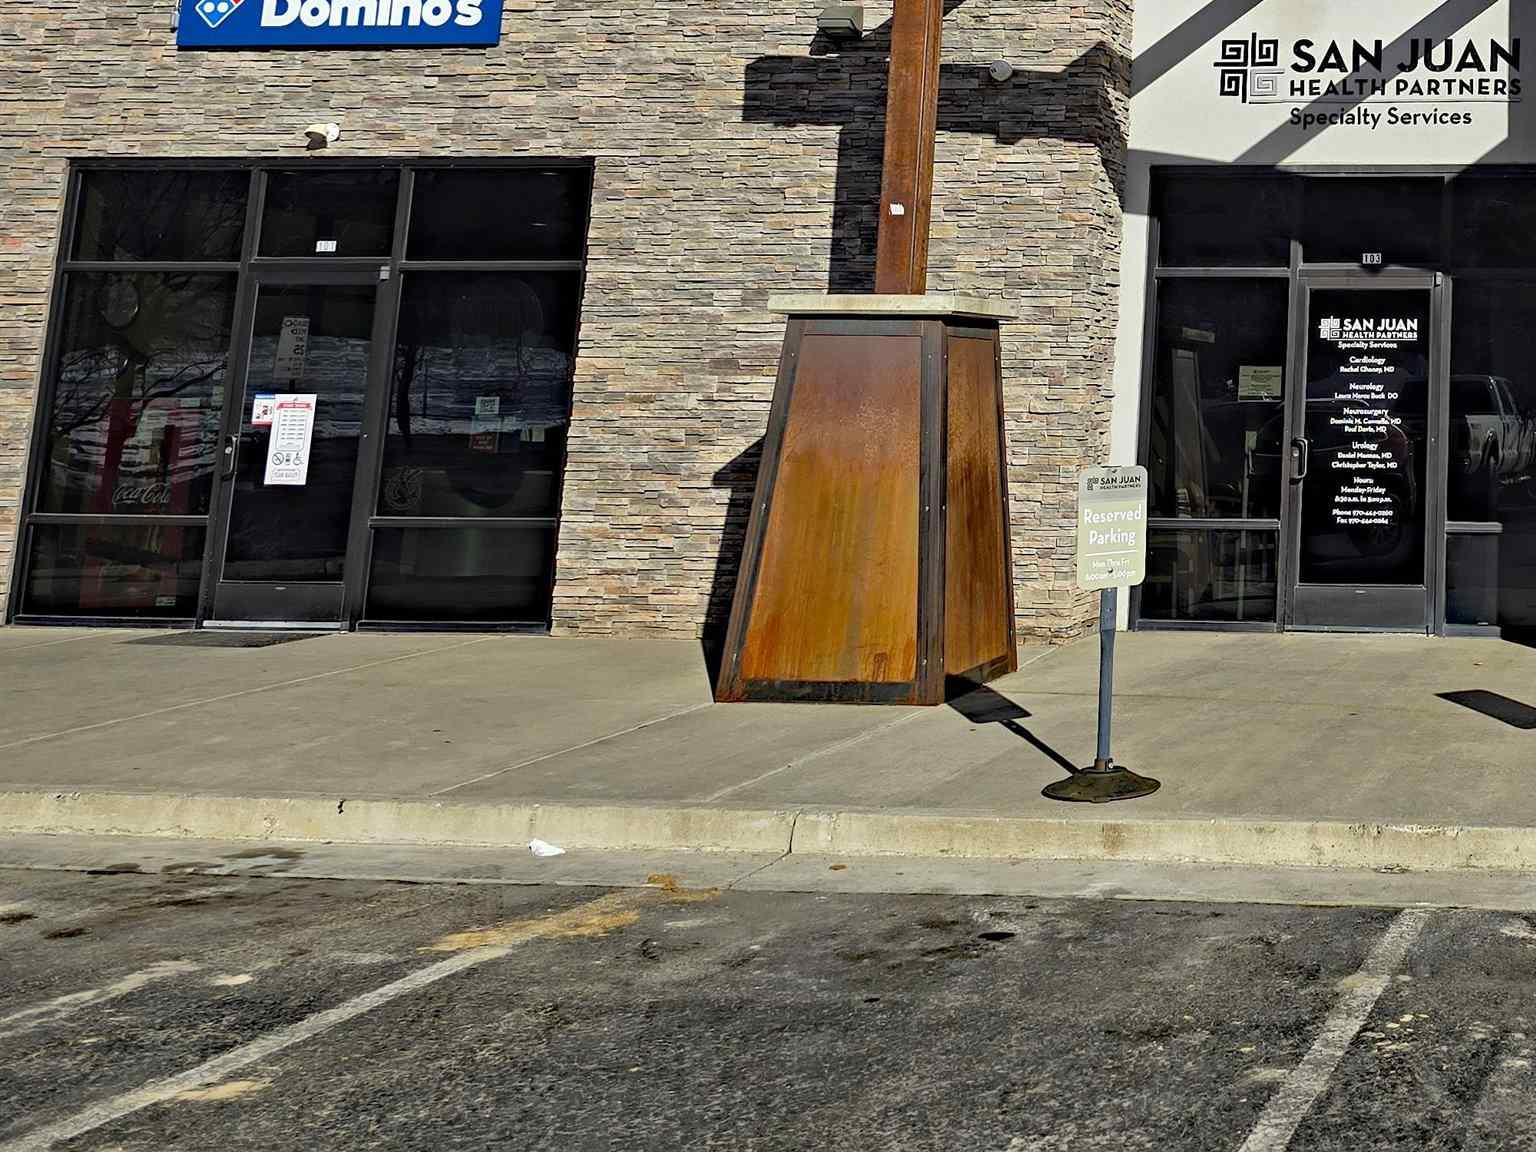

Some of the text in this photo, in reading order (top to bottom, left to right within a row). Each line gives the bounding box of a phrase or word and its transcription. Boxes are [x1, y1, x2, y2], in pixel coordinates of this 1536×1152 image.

[1290, 38, 1521, 73] SAN JUAN
[1290, 78, 1521, 96] HEALTH PARTNERS
[1290, 107, 1473, 130] Specialty Services
[1343, 318, 1418, 330] SAN JUAN
[1338, 341, 1368, 349] Specialty
[1349, 355, 1386, 365] Cardiology
[1349, 382, 1384, 392] Neurology
[1343, 408, 1388, 417] Neurosurgery
[1352, 441, 1378, 451] Urology
[1100, 475, 1141, 485] SAN JUAN
[1084, 504, 1141, 524] Reserved
[1089, 528, 1136, 545] Parking
